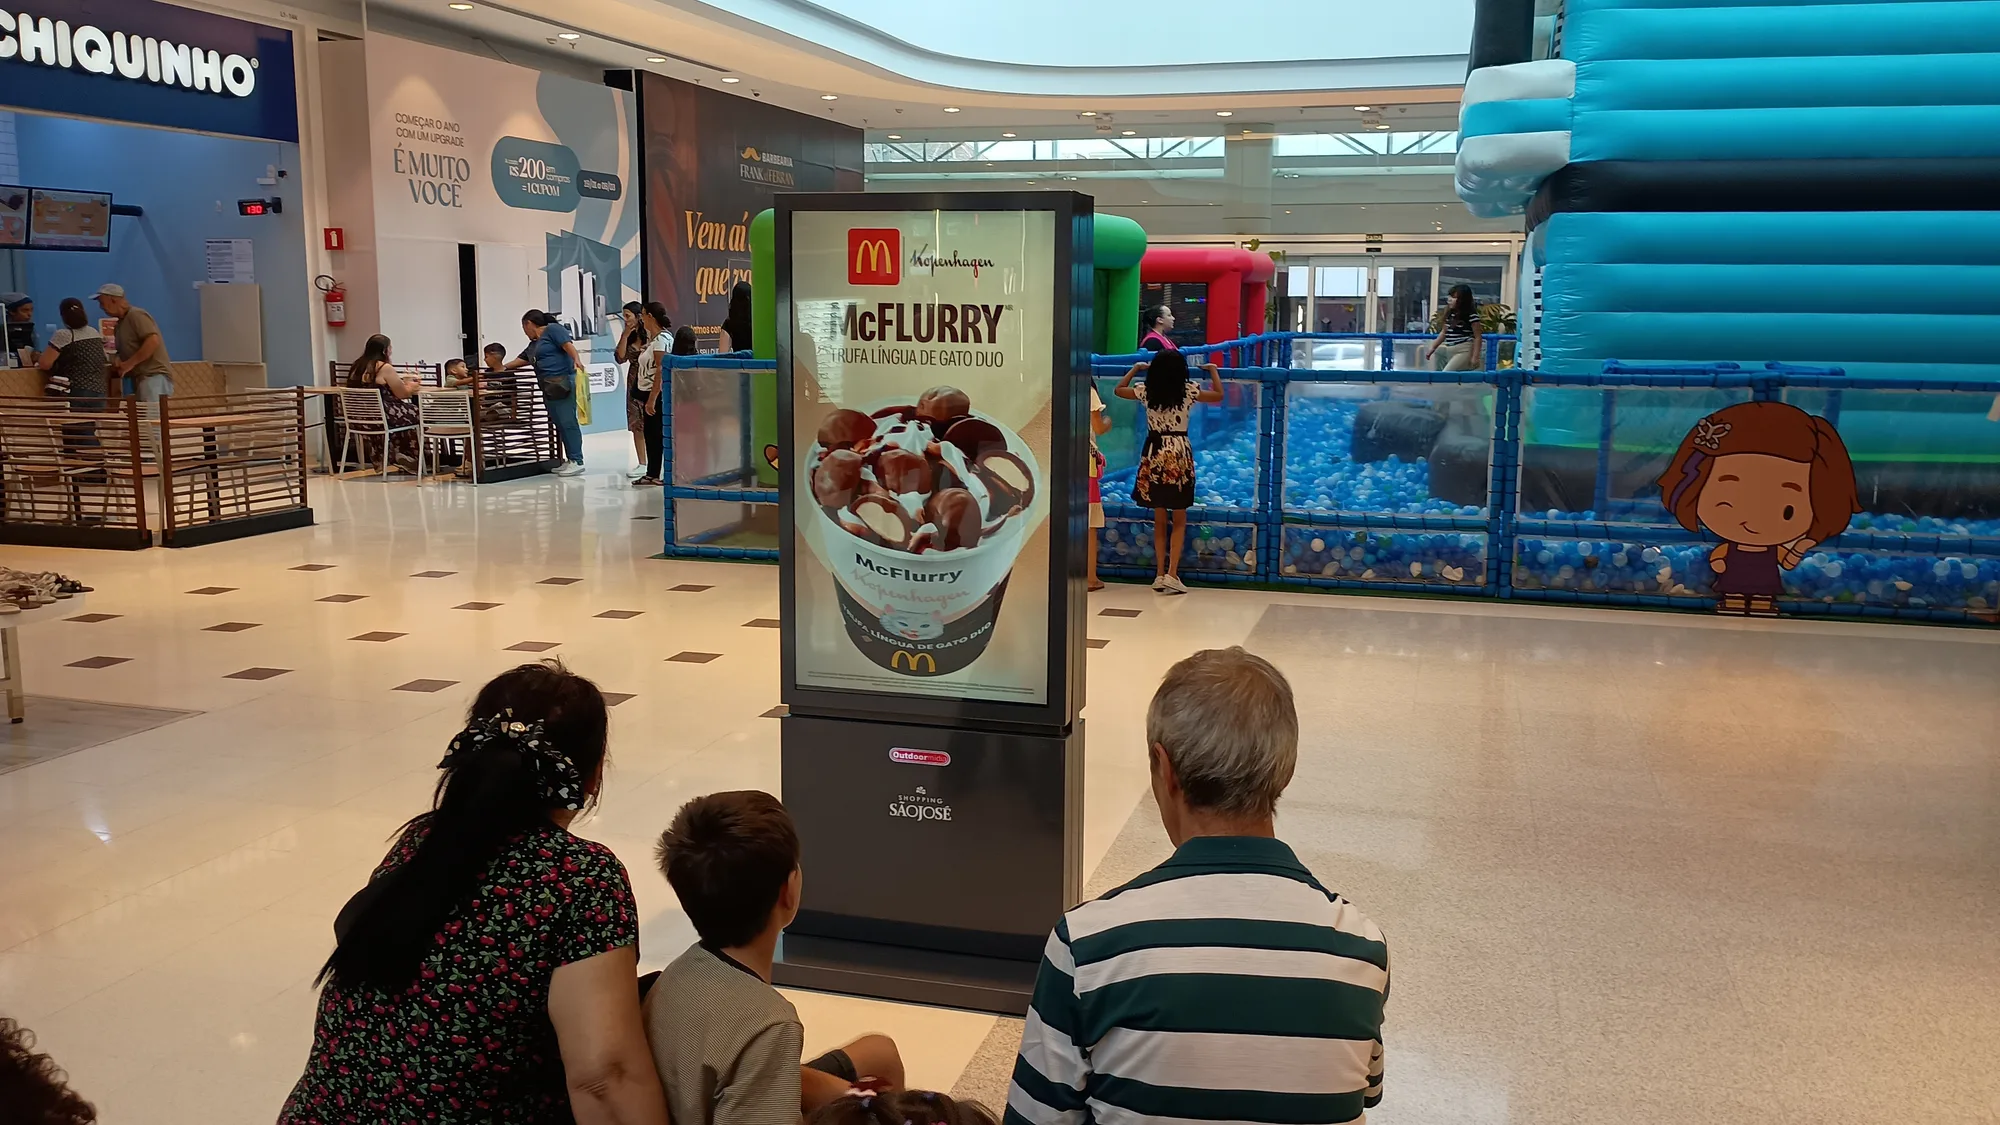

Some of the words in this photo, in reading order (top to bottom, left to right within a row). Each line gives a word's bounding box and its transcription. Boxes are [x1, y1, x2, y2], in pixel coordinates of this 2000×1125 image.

[0, 9, 255, 97] CHIQUINHO
[395, 113, 435, 129] COMEÇAR
[435, 120, 442, 129] O
[444, 121, 460, 132] ANO
[396, 127, 415, 139] COM
[416, 131, 429, 141] UM
[430, 133, 464, 147] UPGRADE
[394, 141, 405, 174] É
[408, 150, 470, 182] MUITO
[519, 156, 546, 180] 200
[762, 152, 793, 167] BARBEARIA
[408, 178, 462, 208] VOCÊ
[685, 210, 726, 251] Vem
[728, 211, 748, 252] aí
[910, 243, 994, 278] Kopenhagen
[695, 267, 730, 304] que
[832, 302, 1004, 344] McFLURRY
[831, 348, 868, 364] TRUFA
[872, 345, 917, 366] LÍNGUA
[920, 350, 936, 366] DE
[939, 350, 973, 367] GATO
[976, 351, 1004, 368] DUO
[855, 553, 963, 584] McFlurry
[870, 629, 915, 649] LÍNGUA
[936, 636, 968, 649] GATO
[970, 621, 992, 639] DUO
[898, 795, 943, 804] SHOPPING
